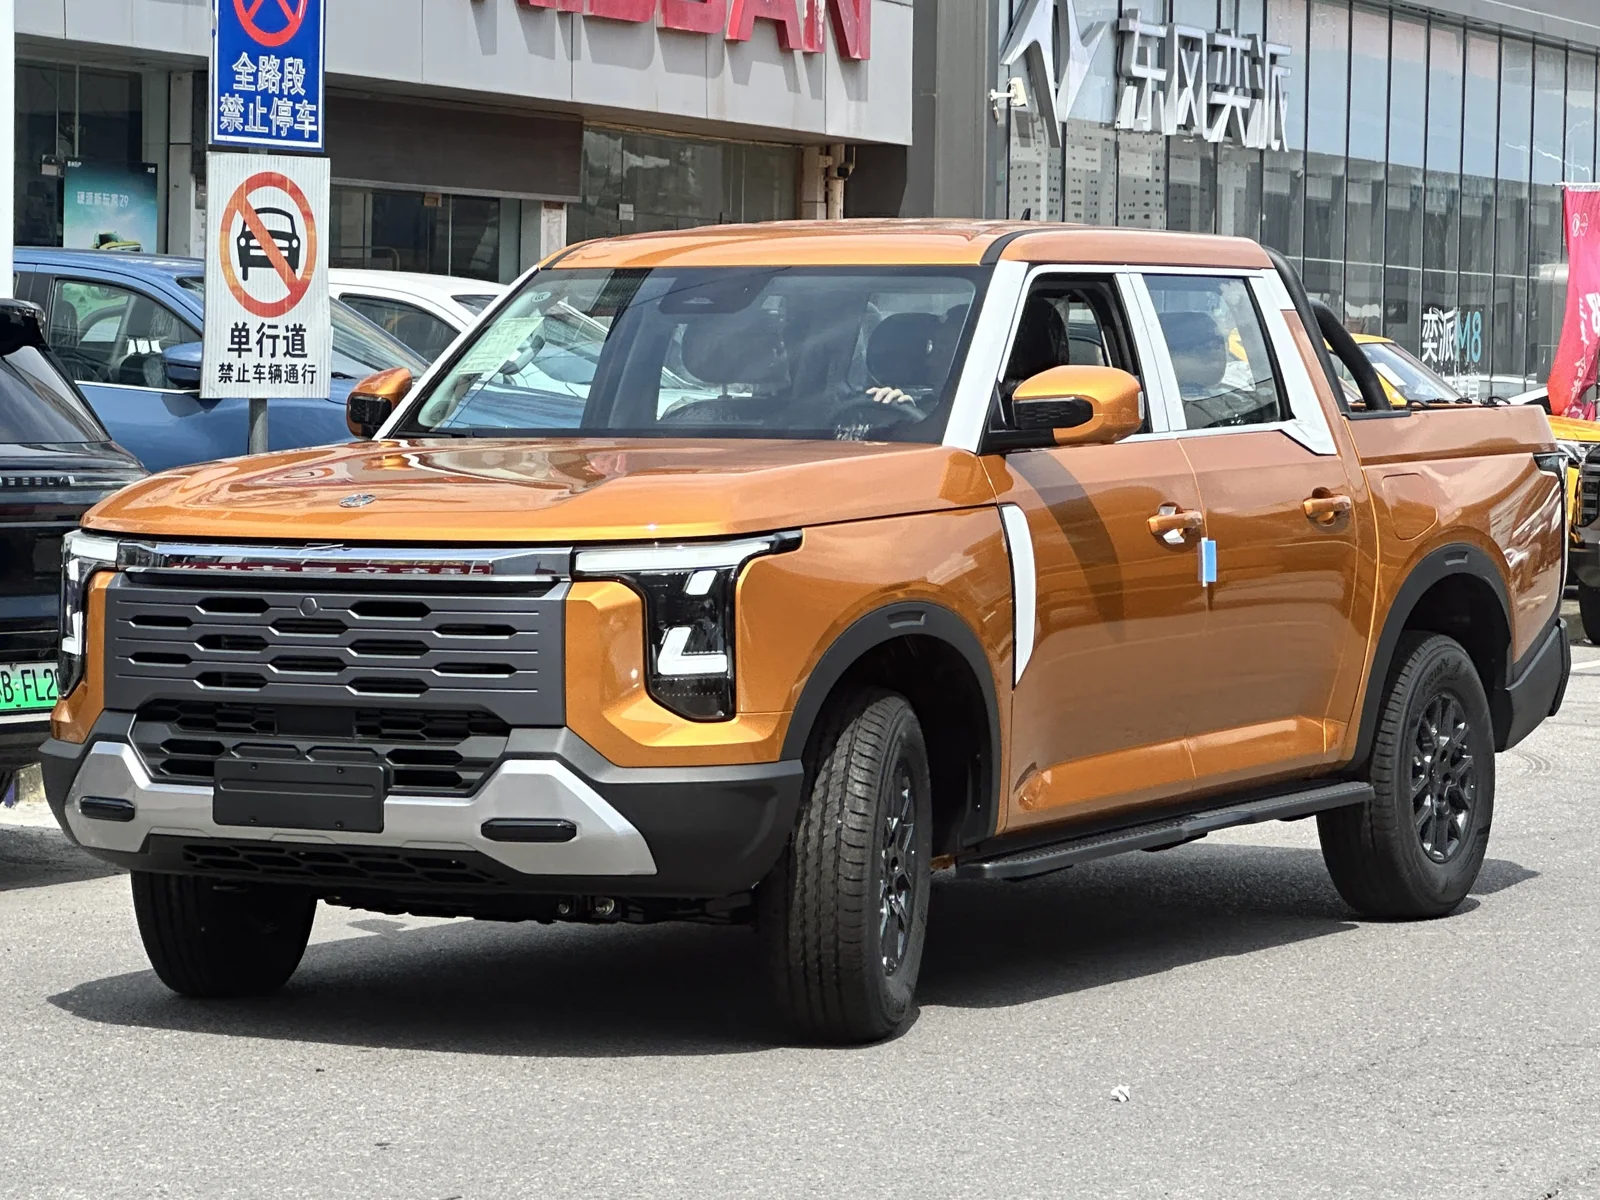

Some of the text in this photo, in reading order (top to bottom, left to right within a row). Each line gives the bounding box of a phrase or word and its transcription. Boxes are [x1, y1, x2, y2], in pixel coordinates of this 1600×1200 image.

[232, 51, 306, 96] 全路段
[1115, 8, 1292, 153] 东风奕派
[219, 93, 318, 138] 禁止停车
[227, 321, 308, 358] 单行道
[217, 362, 317, 385] 禁止车辆通行
